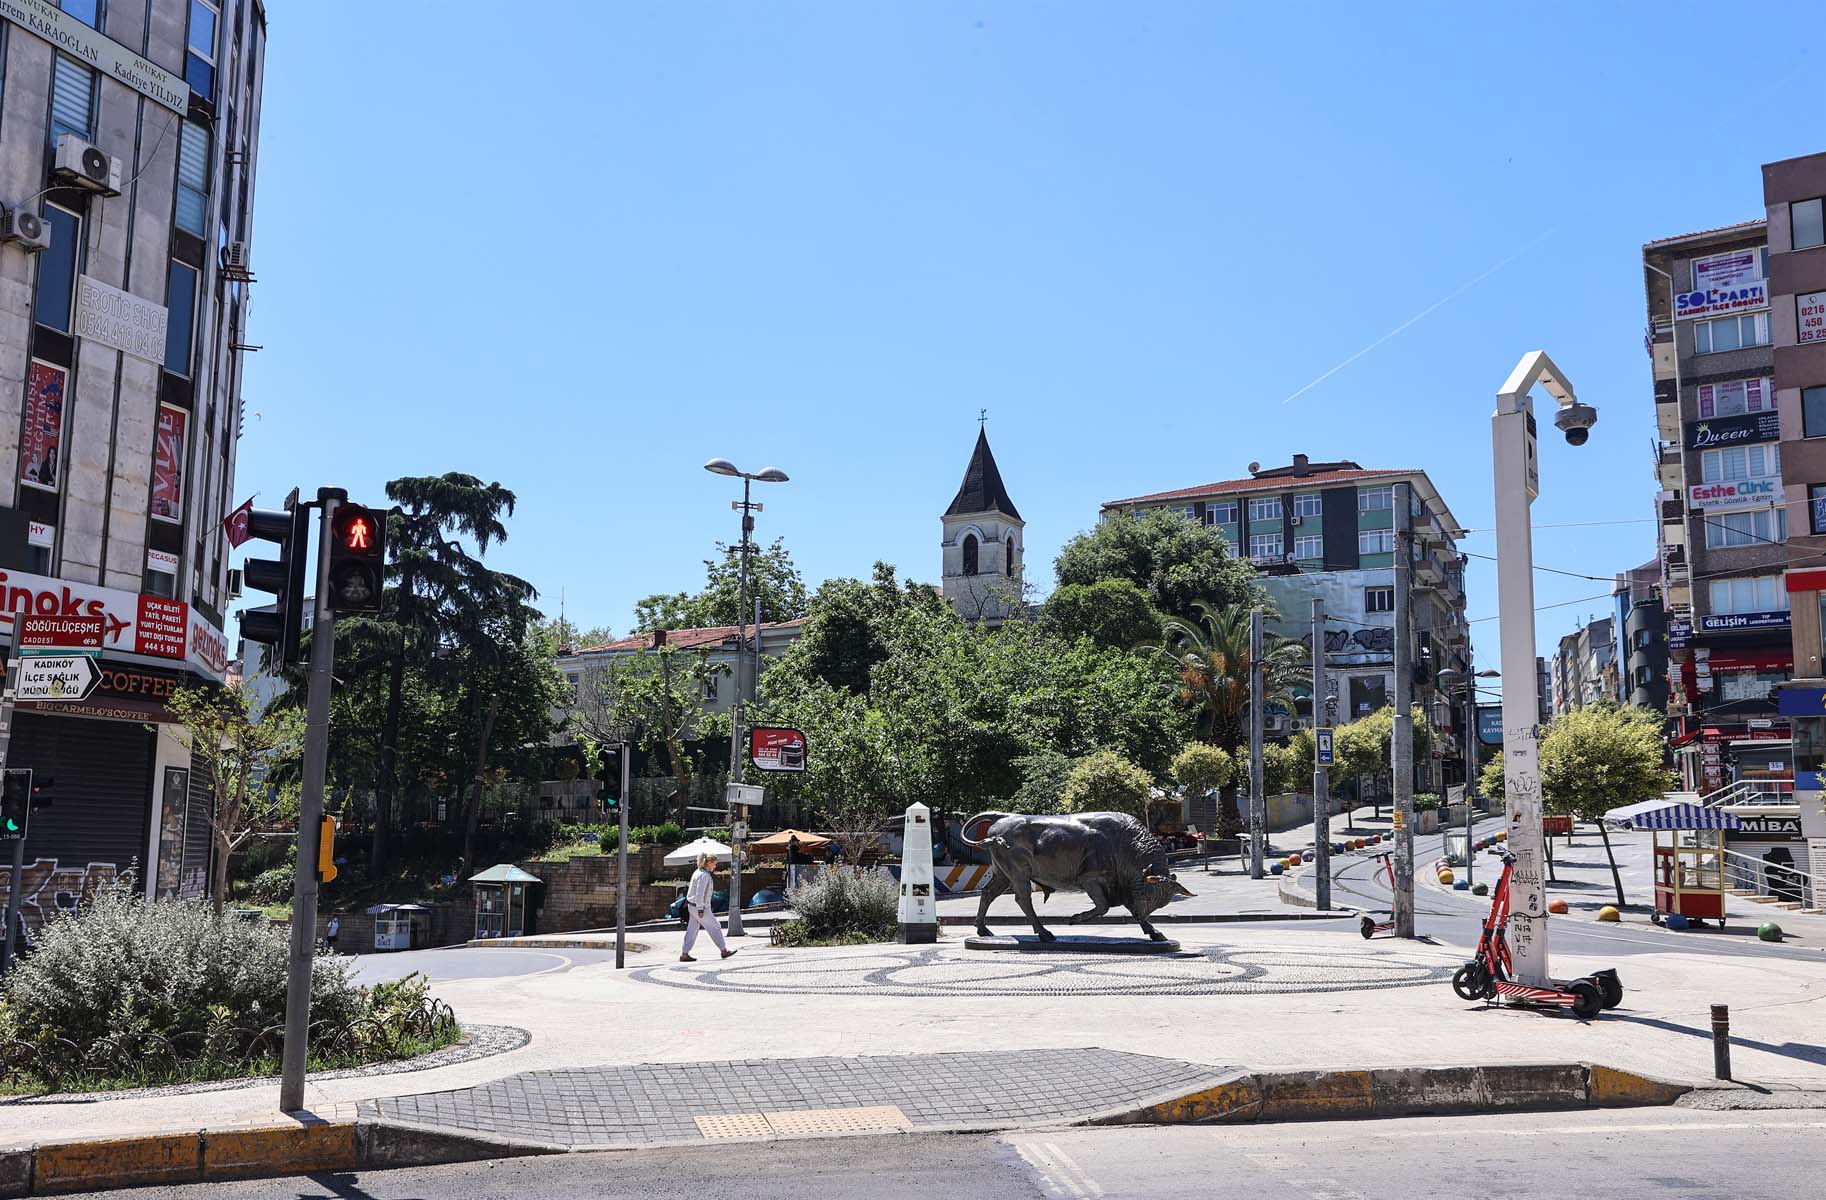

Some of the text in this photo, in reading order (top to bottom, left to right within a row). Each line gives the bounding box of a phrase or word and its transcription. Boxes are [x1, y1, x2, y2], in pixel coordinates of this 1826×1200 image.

[29, 13, 98, 62] KARAOĞLAN
[133, 59, 167, 82] AVUKAT
[114, 61, 183, 109] Kadriye YILDIZ
[1677, 290, 1718, 309] SOL
[1677, 305, 1710, 316] KADIKÖY
[1801, 304, 1825, 316] 0216
[133, 304, 166, 334] SHOP
[1805, 317, 1823, 327] 450
[80, 310, 164, 361] 0544 418 04 02
[1801, 328, 1826, 340] 25 25
[1693, 428, 1750, 448] Queen
[1693, 480, 1774, 500] Esthe Clinic
[1698, 499, 1719, 507] Estetik
[1752, 494, 1773, 503] Eğitim
[30, 525, 45, 535] HY
[148, 552, 177, 564] PEGASUS
[146, 601, 180, 613] UÇAK BİLETİ
[145, 611, 181, 624] TATİL PAKETİ
[1705, 615, 1747, 628] GELİŞİM
[25, 619, 100, 634] SÖĞÜTLÜÇEŞME
[140, 620, 155, 629] YURT
[163, 624, 183, 634] TURLAR
[23, 636, 54, 644] CADDESİ
[139, 630, 153, 639] YURT
[164, 634, 183, 644] TURLAR
[144, 642, 158, 650] 444
[166, 645, 177, 653] 951
[33, 659, 74, 669] KADIKÖY
[24, 672, 80, 683] İLÇE SAĞLIK
[101, 671, 178, 697] COFFEE
[36, 701, 150, 721] BIG CARMELO'S COFFEE
[1740, 818, 1799, 832] MİBA
